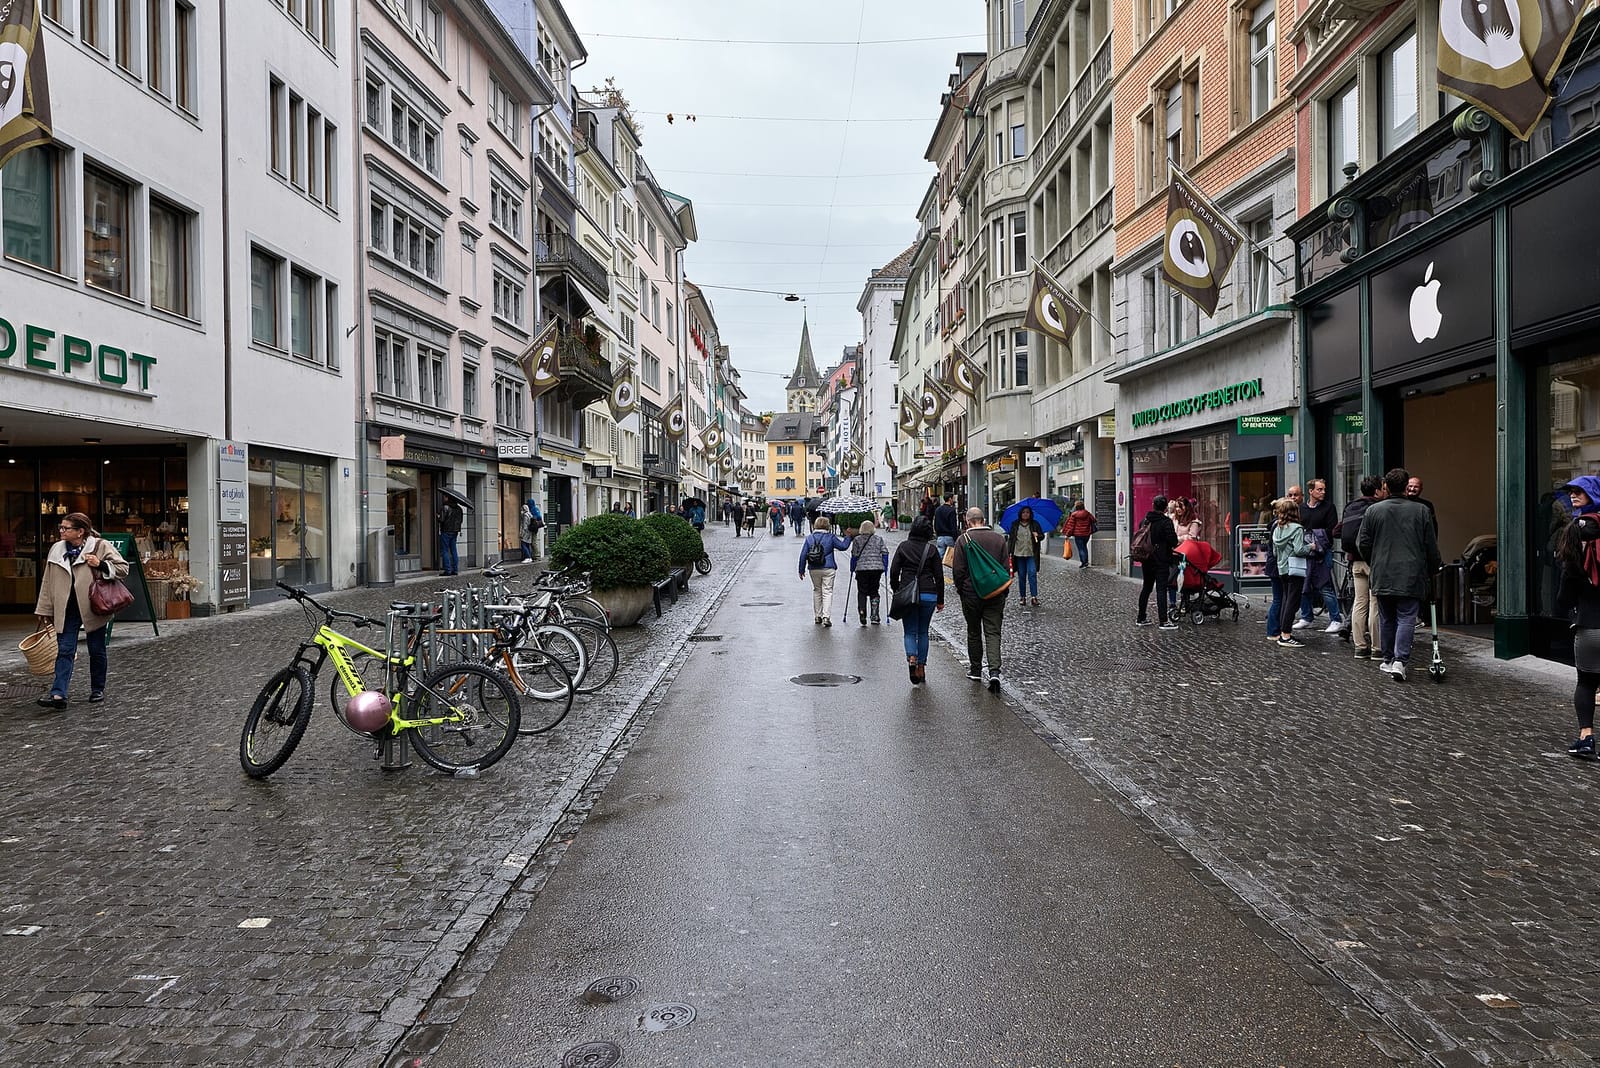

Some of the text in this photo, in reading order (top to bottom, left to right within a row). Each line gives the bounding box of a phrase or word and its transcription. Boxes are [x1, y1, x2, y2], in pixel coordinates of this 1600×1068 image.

[1131, 406, 1159, 429] UNITED
[1158, 397, 1192, 421] COLORS
[1192, 395, 1207, 414] OF
[499, 445, 528, 455] BREE
